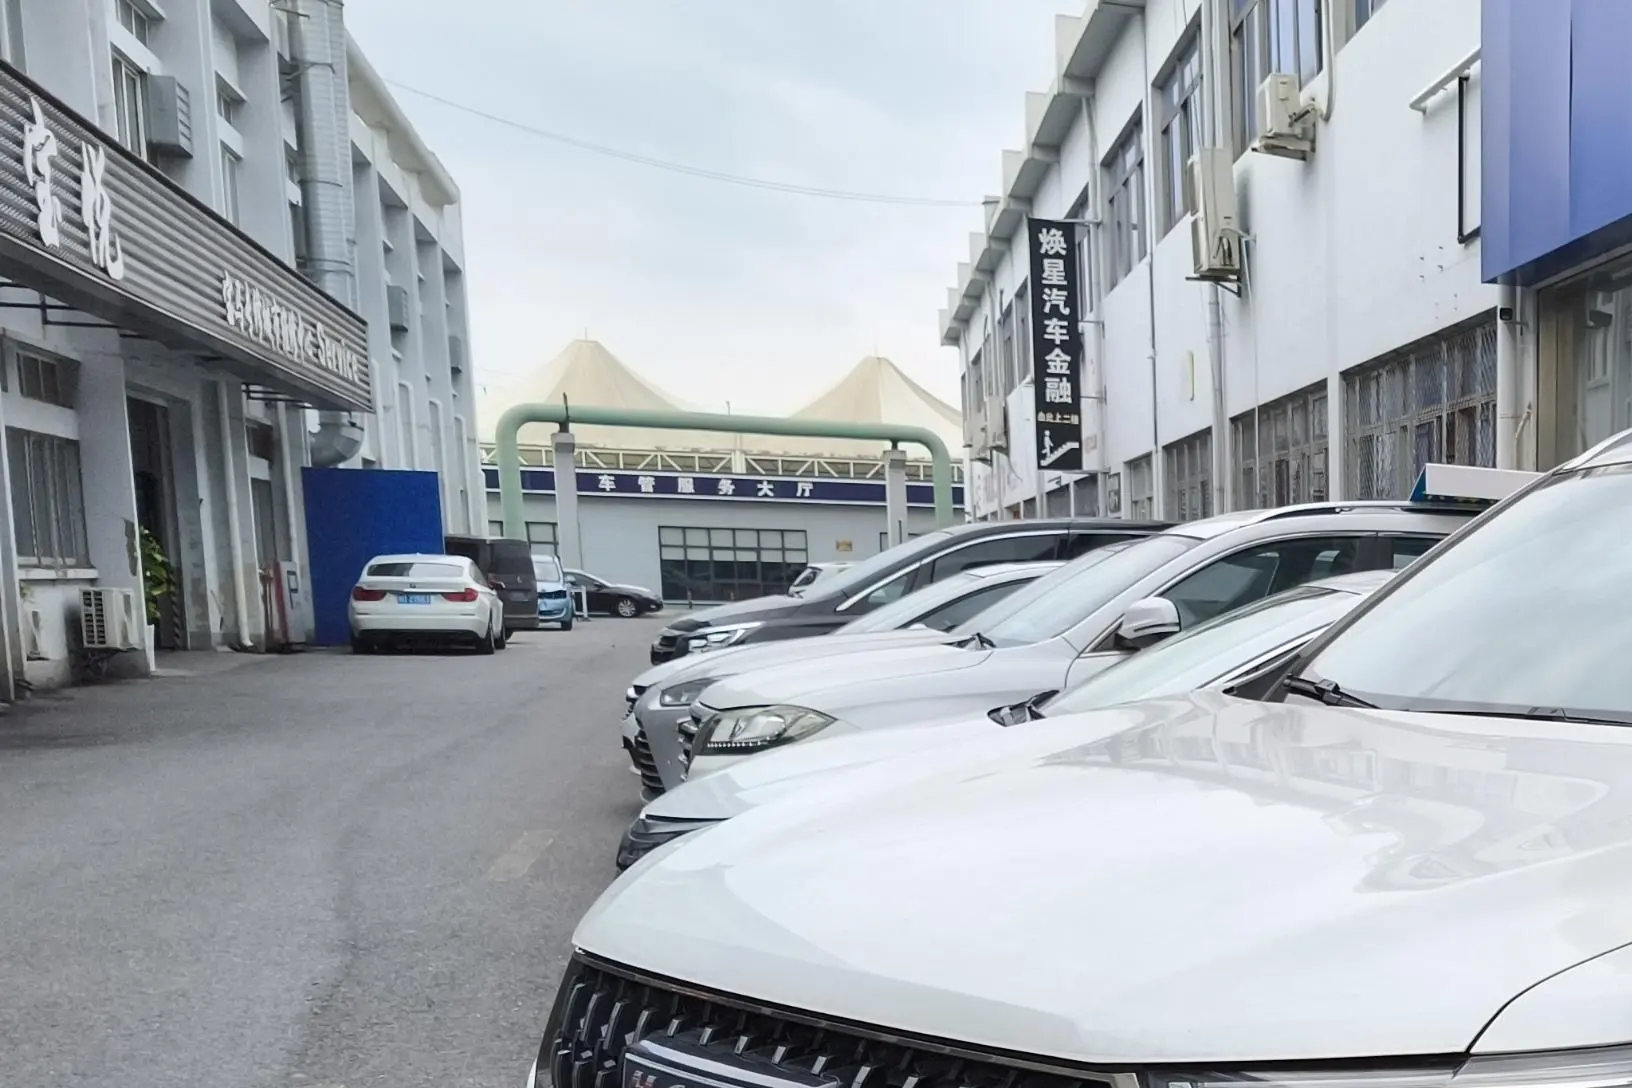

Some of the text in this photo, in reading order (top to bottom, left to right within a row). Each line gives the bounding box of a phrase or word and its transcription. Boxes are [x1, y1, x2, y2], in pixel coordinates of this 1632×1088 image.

[1038, 228, 1073, 403] 焕星汽车金融
[598, 474, 814, 498] 车管服务大厅
